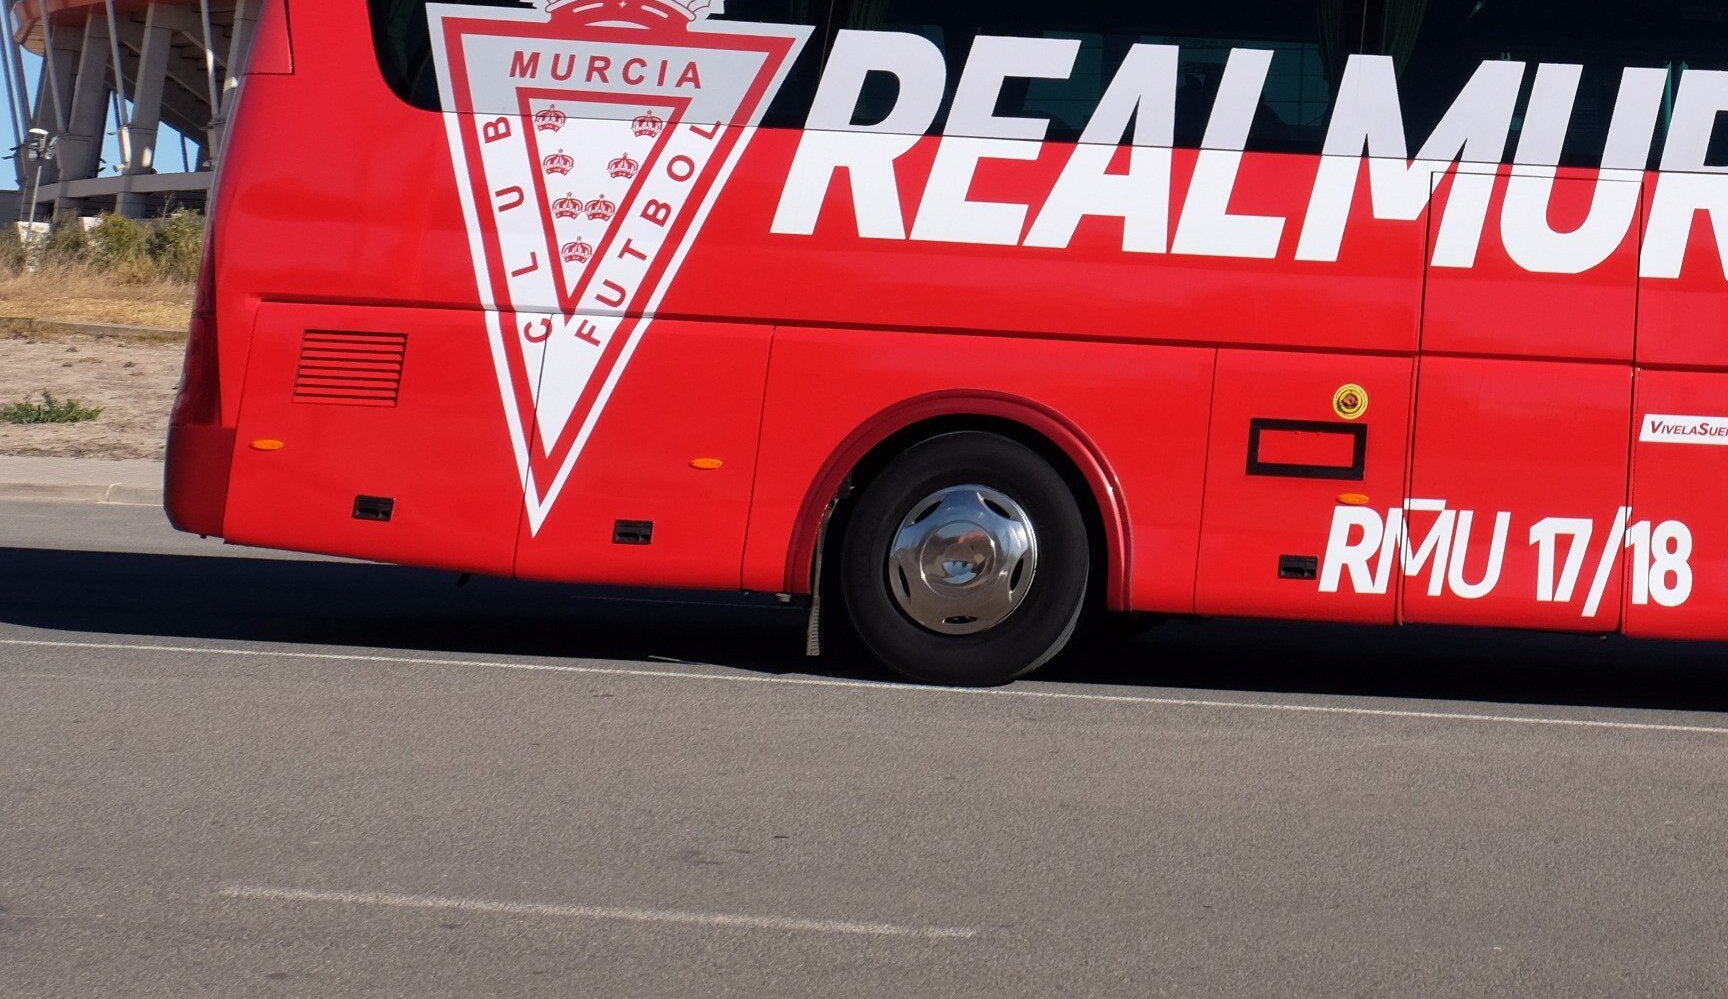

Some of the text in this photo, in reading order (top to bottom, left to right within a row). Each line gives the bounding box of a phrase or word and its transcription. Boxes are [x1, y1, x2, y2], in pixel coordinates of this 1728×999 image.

[509, 50, 703, 89] MURCIA
[575, 118, 724, 347] FUTBOL
[1528, 505, 1694, 618] 17/18
